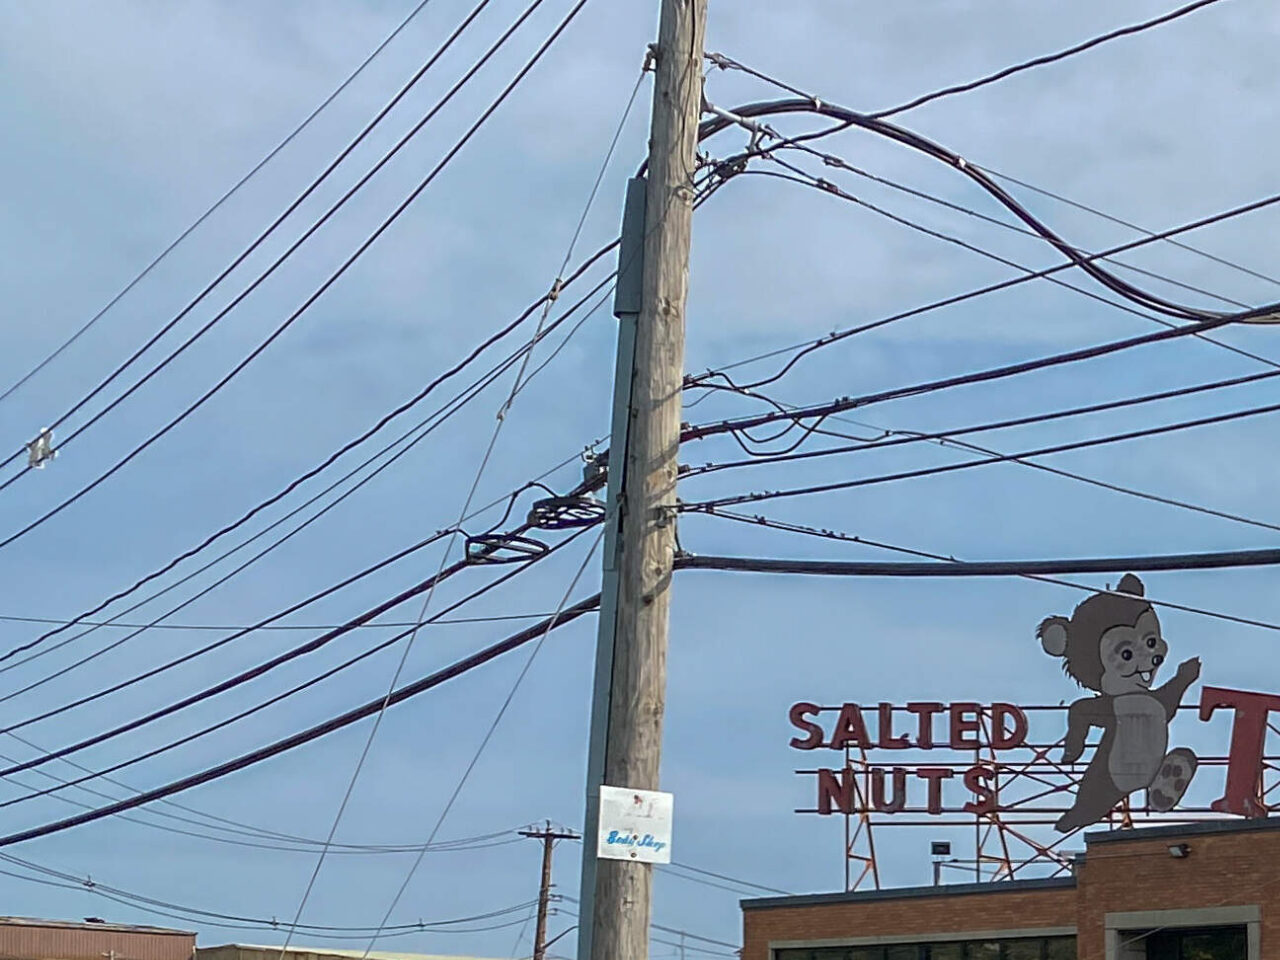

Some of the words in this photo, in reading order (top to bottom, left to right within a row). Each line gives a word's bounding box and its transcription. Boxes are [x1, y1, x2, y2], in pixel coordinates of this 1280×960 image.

[789, 702, 1029, 750] SALTED
[818, 766, 996, 814] NUTS
[637, 834, 666, 853] Shop
